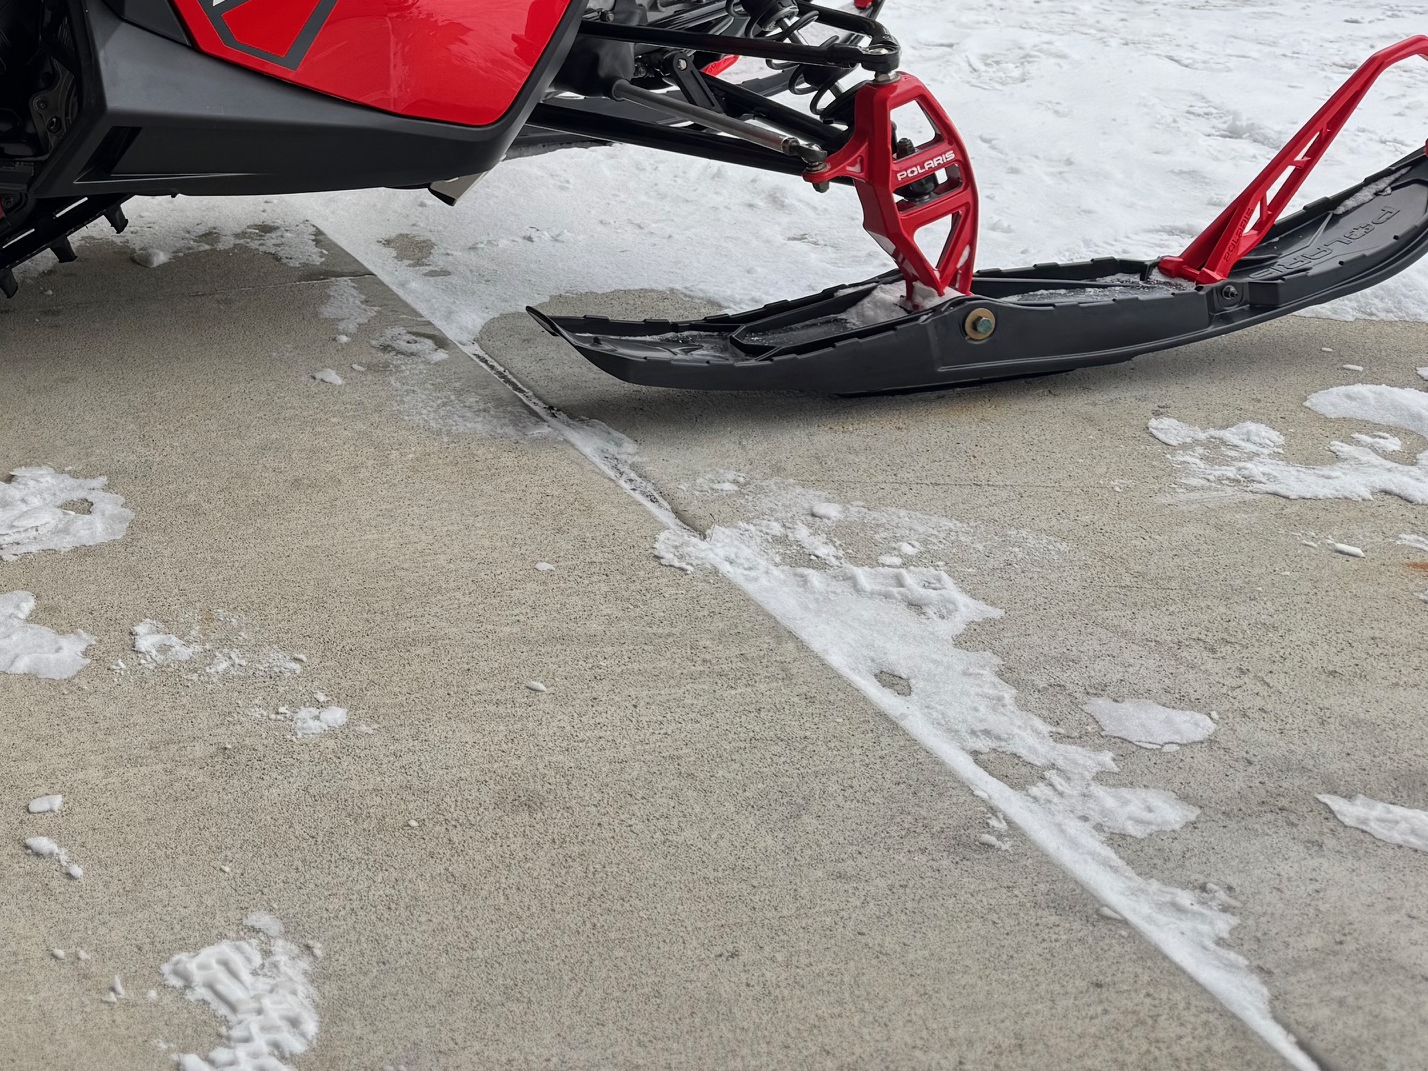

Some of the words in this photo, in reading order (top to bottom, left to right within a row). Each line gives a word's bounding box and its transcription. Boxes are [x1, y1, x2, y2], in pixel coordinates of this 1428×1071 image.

[896, 150, 956, 181] POLARIS
[1222, 207, 1255, 263] POLARIS
[1248, 205, 1401, 280] POLARIS
